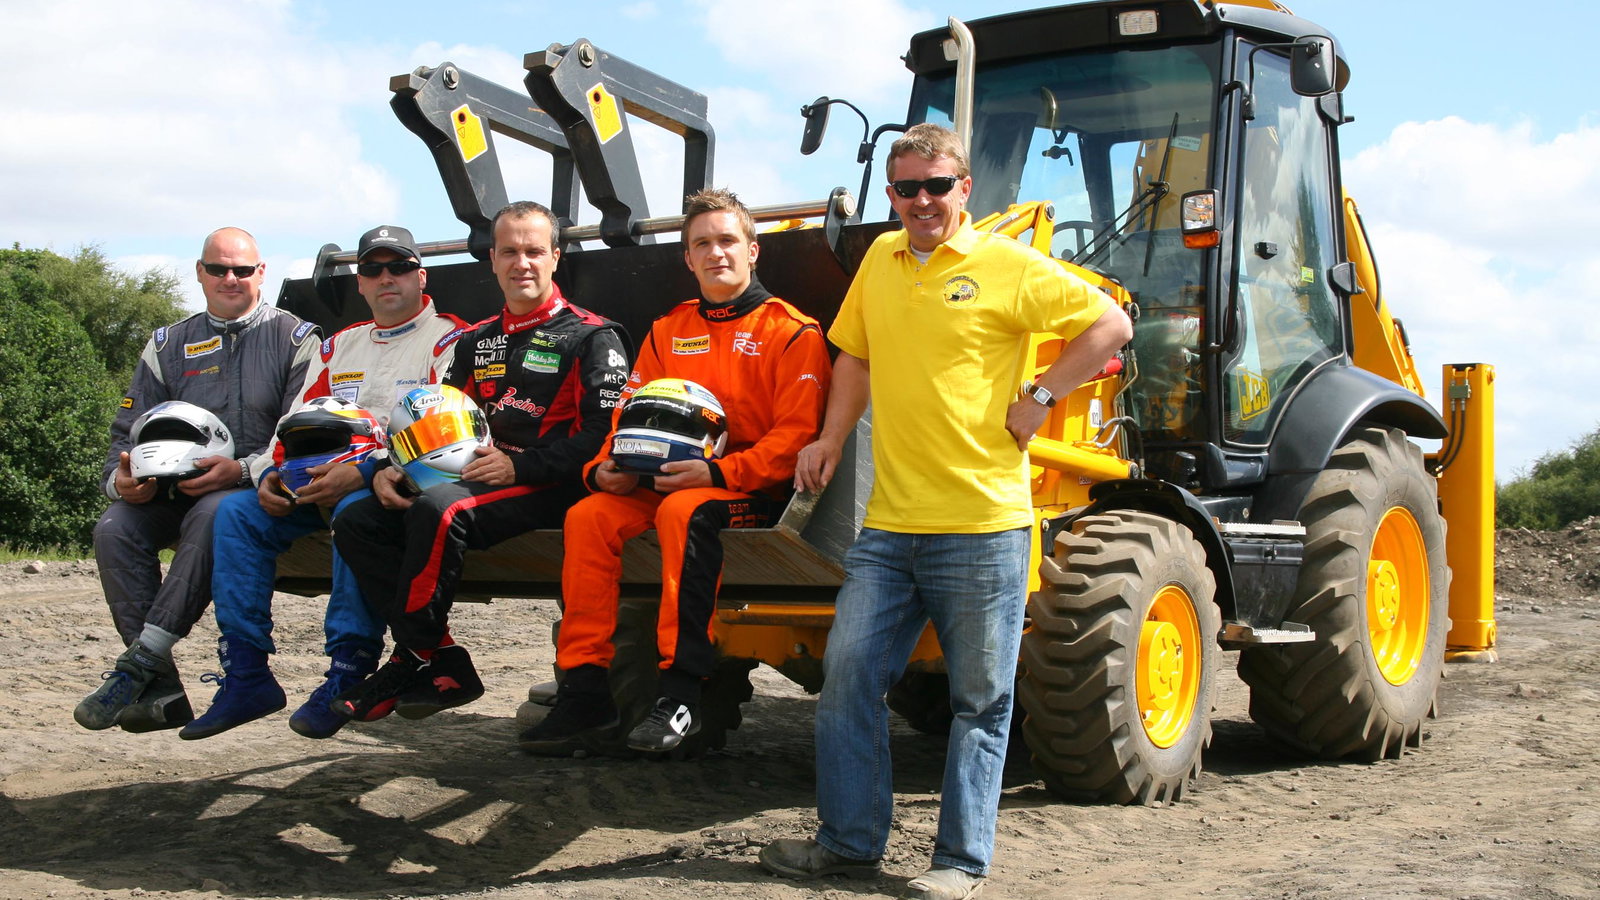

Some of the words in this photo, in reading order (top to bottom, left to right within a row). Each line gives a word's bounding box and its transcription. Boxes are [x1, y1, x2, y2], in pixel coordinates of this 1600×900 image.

[515, 317, 541, 328] VAUXHALL
[477, 334, 509, 349] GMAC
[527, 352, 547, 364] Holiday
[604, 373, 624, 385] MSC
[1241, 373, 1269, 415] JCB
[418, 396, 441, 406] Arai
[497, 386, 546, 417] Racing
